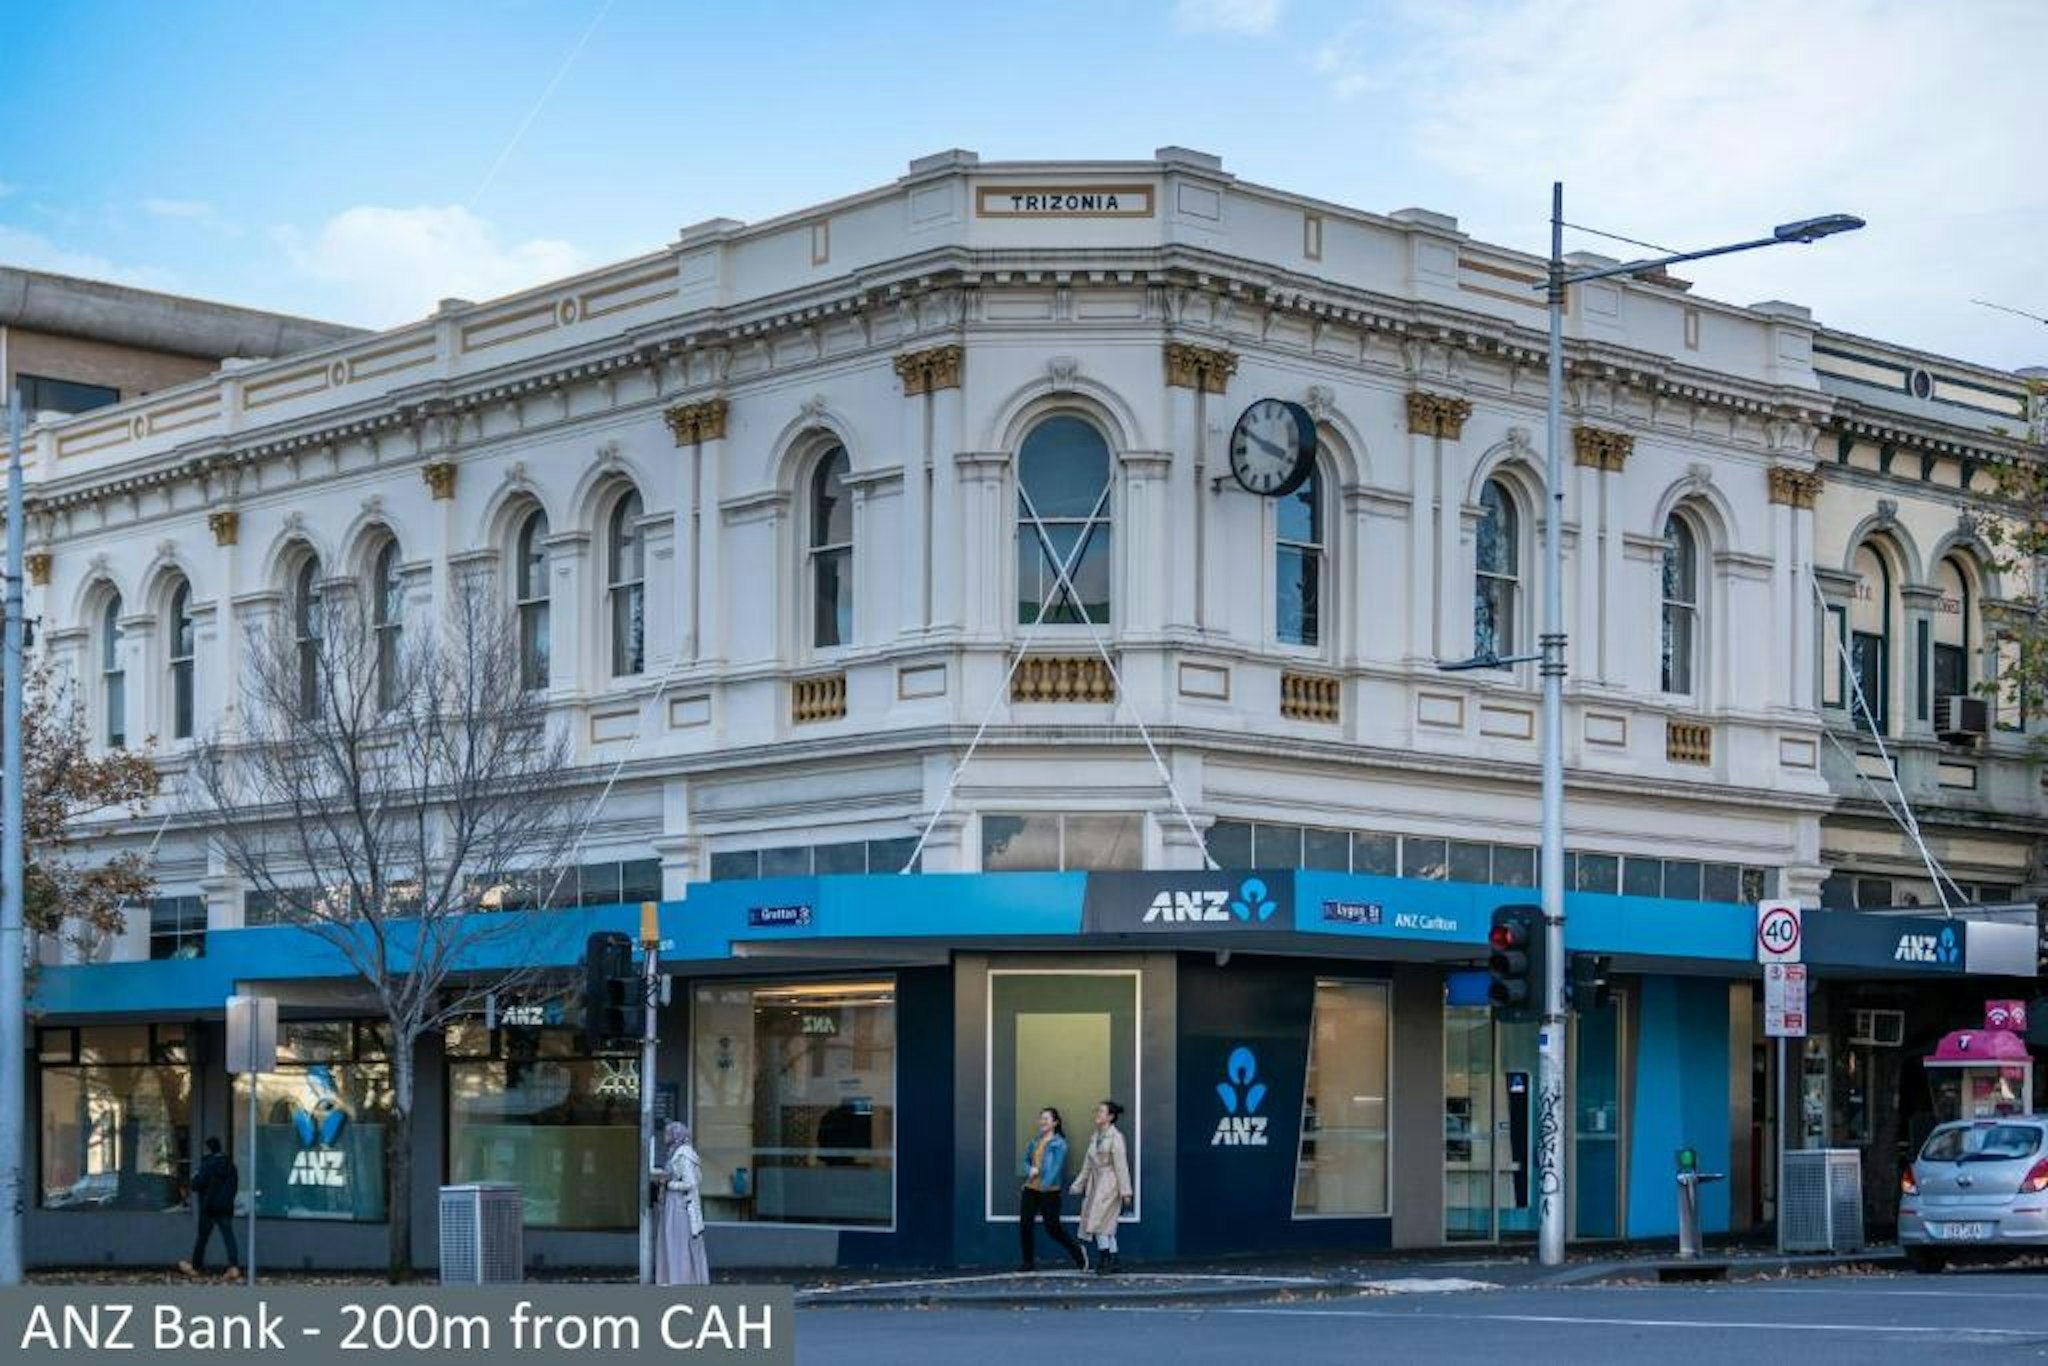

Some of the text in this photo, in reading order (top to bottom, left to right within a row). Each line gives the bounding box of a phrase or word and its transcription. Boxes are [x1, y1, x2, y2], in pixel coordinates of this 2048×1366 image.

[1011, 195, 1118, 210] TRIZONIA
[1142, 891, 1230, 922] ANZ
[1395, 913, 1457, 931] ANZ Carlton
[1766, 919, 1793, 941] 40
[1895, 935, 1937, 962] ANZ
[501, 1005, 543, 1025] ANZ
[1211, 1116, 1268, 1146] ANZ
[288, 1151, 344, 1187] ANZ
